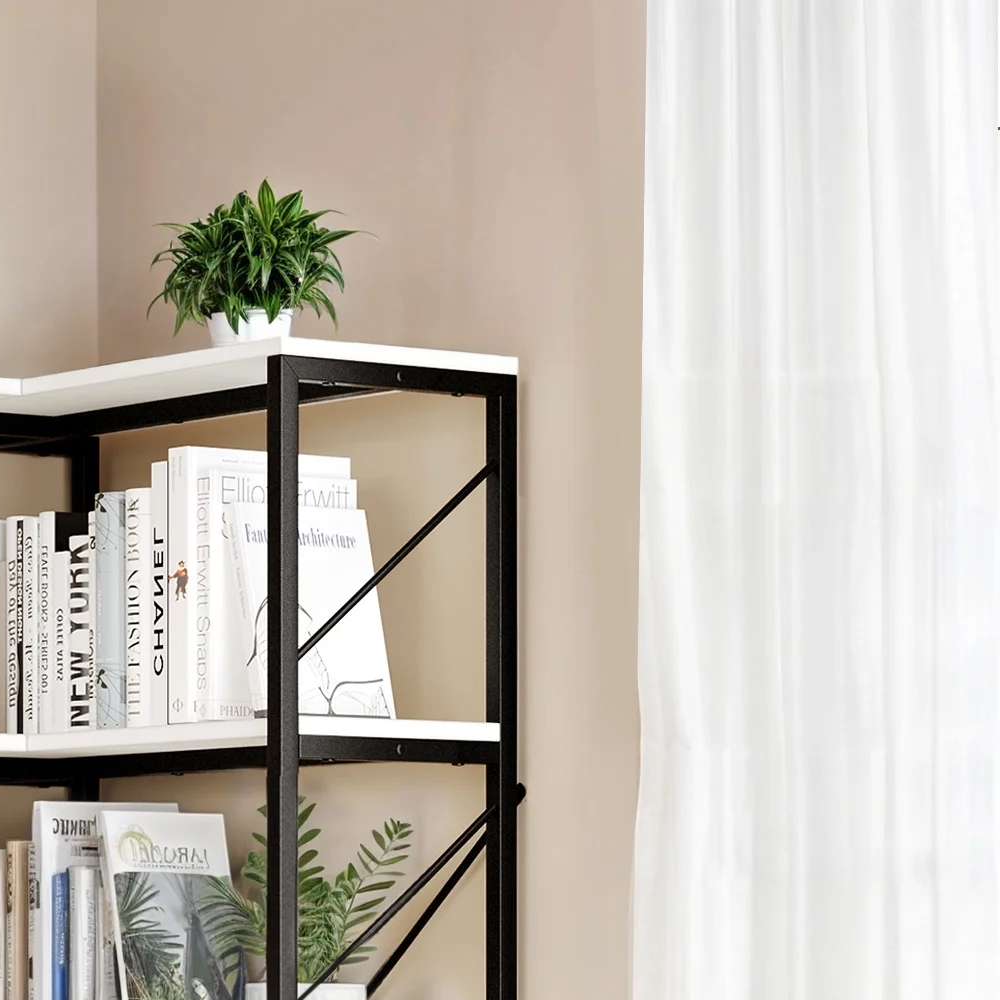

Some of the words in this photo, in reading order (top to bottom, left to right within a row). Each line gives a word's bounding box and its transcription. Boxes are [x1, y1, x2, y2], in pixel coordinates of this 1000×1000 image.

[196, 477, 210, 535] Elliott
[222, 475, 266, 504] Ellio
[127, 497, 140, 562] BOOK
[70, 542, 90, 633] YORK
[196, 545, 210, 607] Erwitt
[127, 569, 140, 669] FASHION
[70, 651, 90, 728] NEW
[127, 673, 140, 721] THE
[220, 705, 254, 717] PHAID
